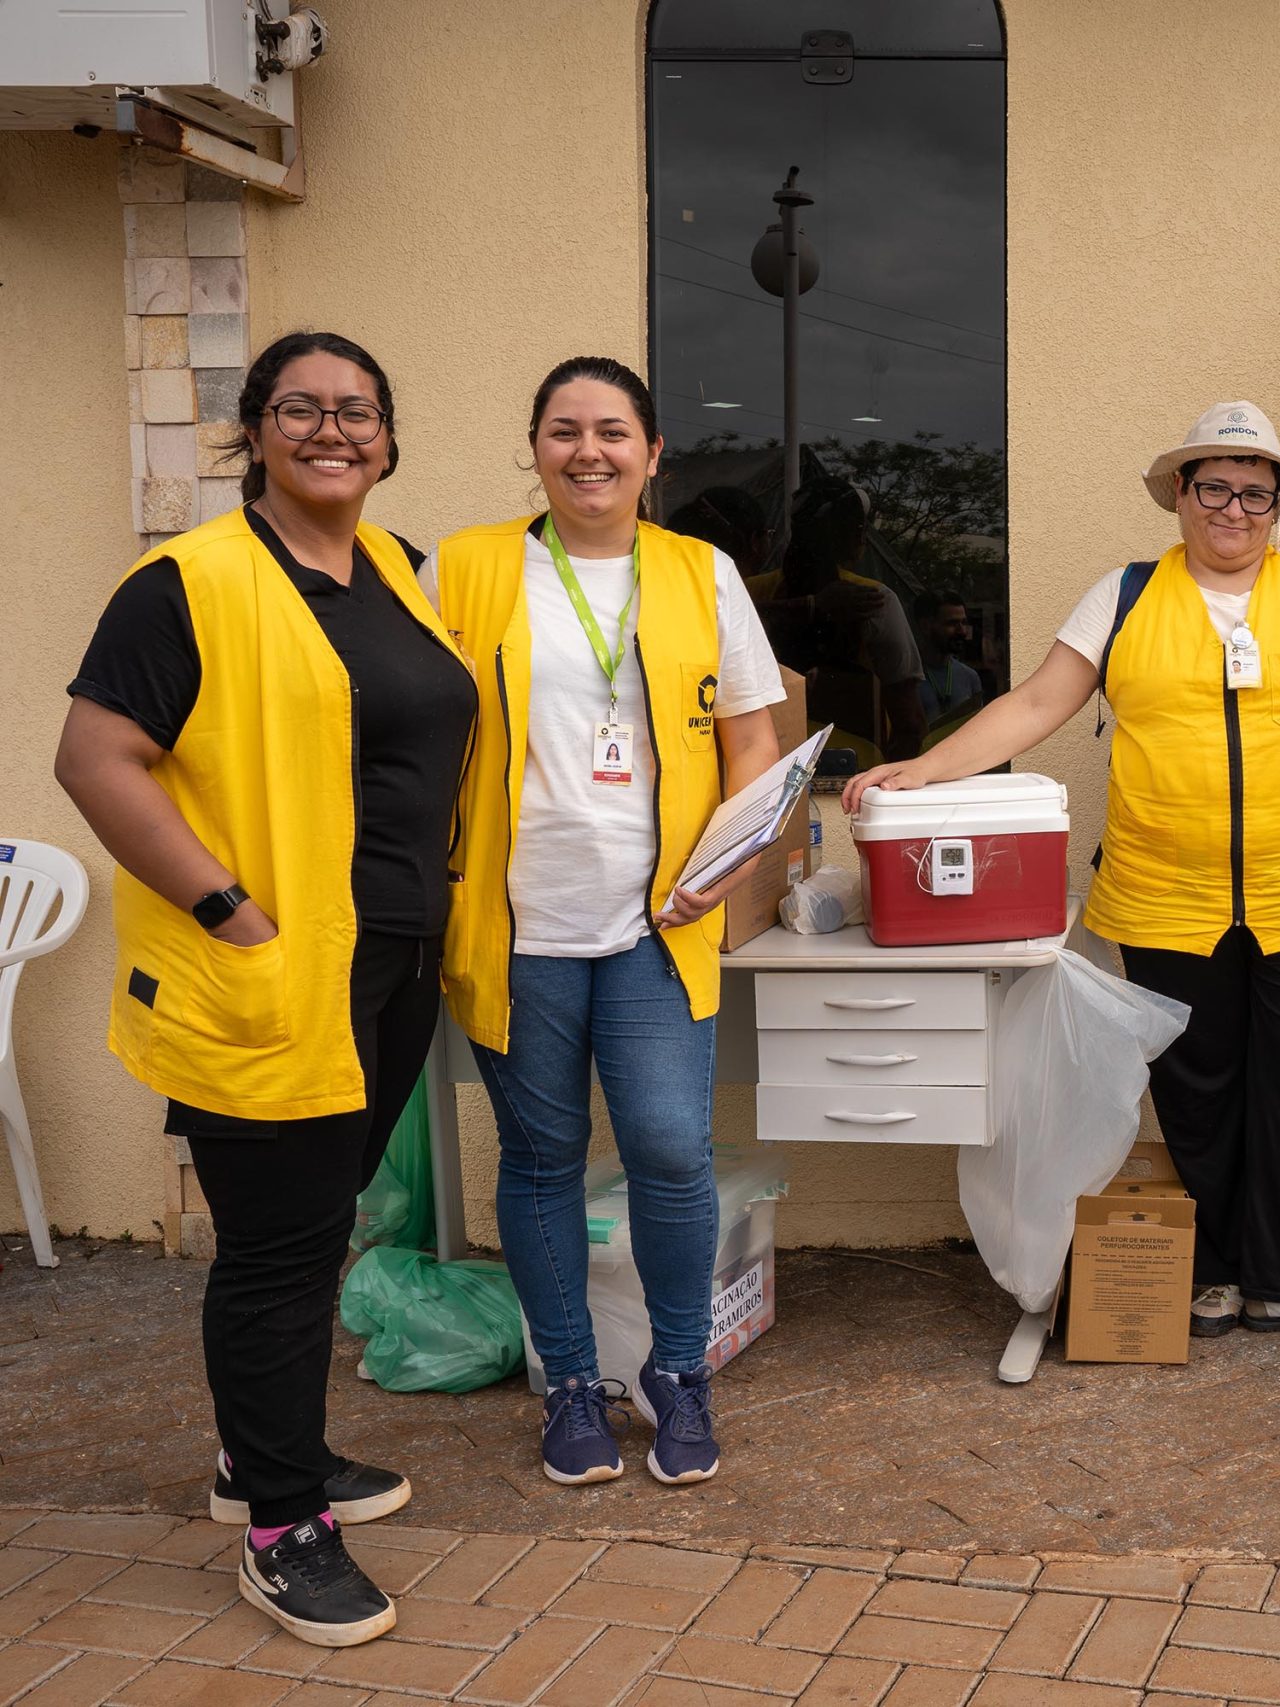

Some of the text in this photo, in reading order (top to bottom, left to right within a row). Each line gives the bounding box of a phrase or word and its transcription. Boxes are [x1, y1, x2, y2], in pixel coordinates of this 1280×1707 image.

[1218, 427, 1258, 437] RONDON
[1097, 1235, 1129, 1244] COLETOR
[1139, 1237, 1174, 1245] MATERIAIS
[1100, 1243, 1170, 1251] PERFUROCORTANTES
[712, 1271, 758, 1318] ACINAÇÃO
[269, 1574, 289, 1592] FILA
